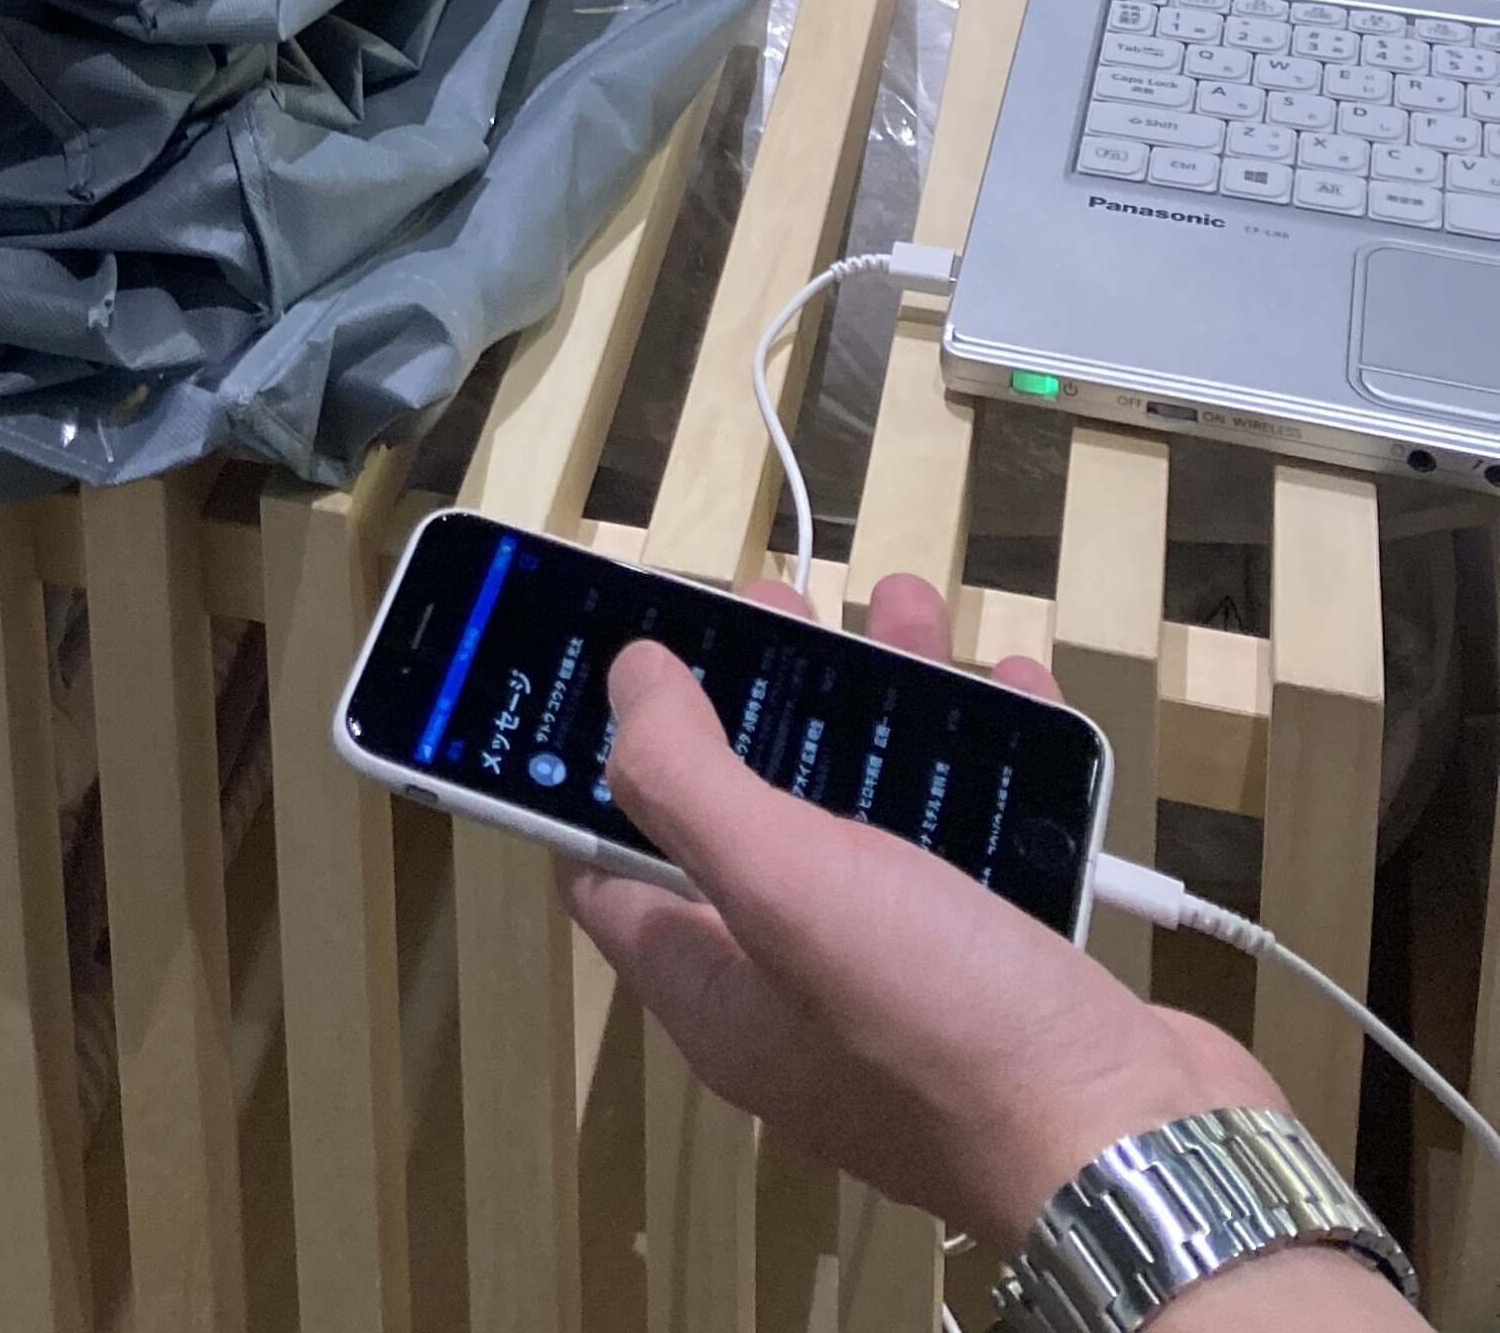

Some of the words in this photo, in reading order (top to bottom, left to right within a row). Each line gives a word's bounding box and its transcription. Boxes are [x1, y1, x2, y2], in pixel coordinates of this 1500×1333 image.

[1172, 23, 1180, 31] 1
[1238, 32, 1249, 41] 2
[1117, 43, 1141, 54] Tab
[1308, 42, 1319, 51] 3
[1198, 50, 1214, 61] Q
[1376, 51, 1388, 60] 4
[1269, 59, 1290, 71] W
[1449, 61, 1460, 71] 5
[1340, 70, 1350, 80] E
[1111, 73, 1144, 85] Caps
[1148, 77, 1179, 89] Lock
[1409, 80, 1423, 91] R
[1211, 87, 1227, 96] A
[1482, 90, 1495, 101] T
[1283, 97, 1295, 107] S
[1353, 107, 1368, 117] D
[1145, 118, 1179, 131] Shift
[1426, 118, 1438, 128] F
[1243, 127, 1256, 137] Z
[1313, 137, 1327, 149] X
[1387, 149, 1402, 161] C
[1170, 160, 1196, 171] Ctrl
[1461, 160, 1477, 171] V
[1088, 196, 1227, 229] Panasonic
[1117, 395, 1142, 409] OFF
[1203, 410, 1226, 425] ON
[1233, 416, 1302, 438] WIRELESS
[481, 668, 531, 775] メッセージ
